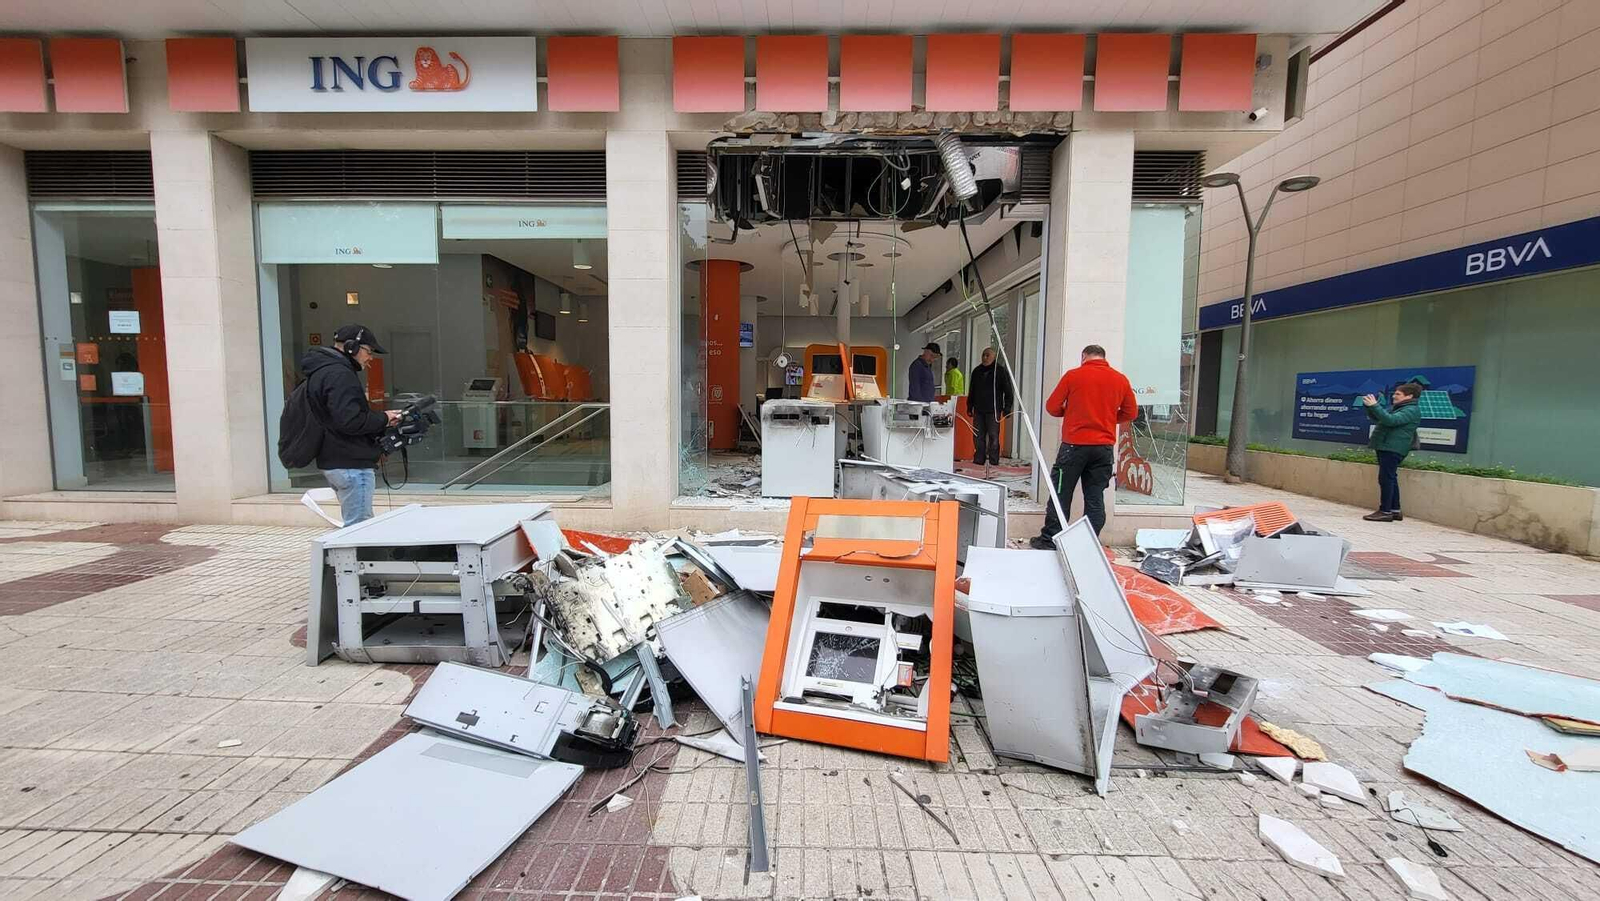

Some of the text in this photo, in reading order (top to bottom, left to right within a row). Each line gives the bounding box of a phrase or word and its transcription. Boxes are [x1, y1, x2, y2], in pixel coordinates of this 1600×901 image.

[308, 56, 403, 90] ING
[518, 220, 535, 228] ING
[1465, 237, 1552, 276] BBVA
